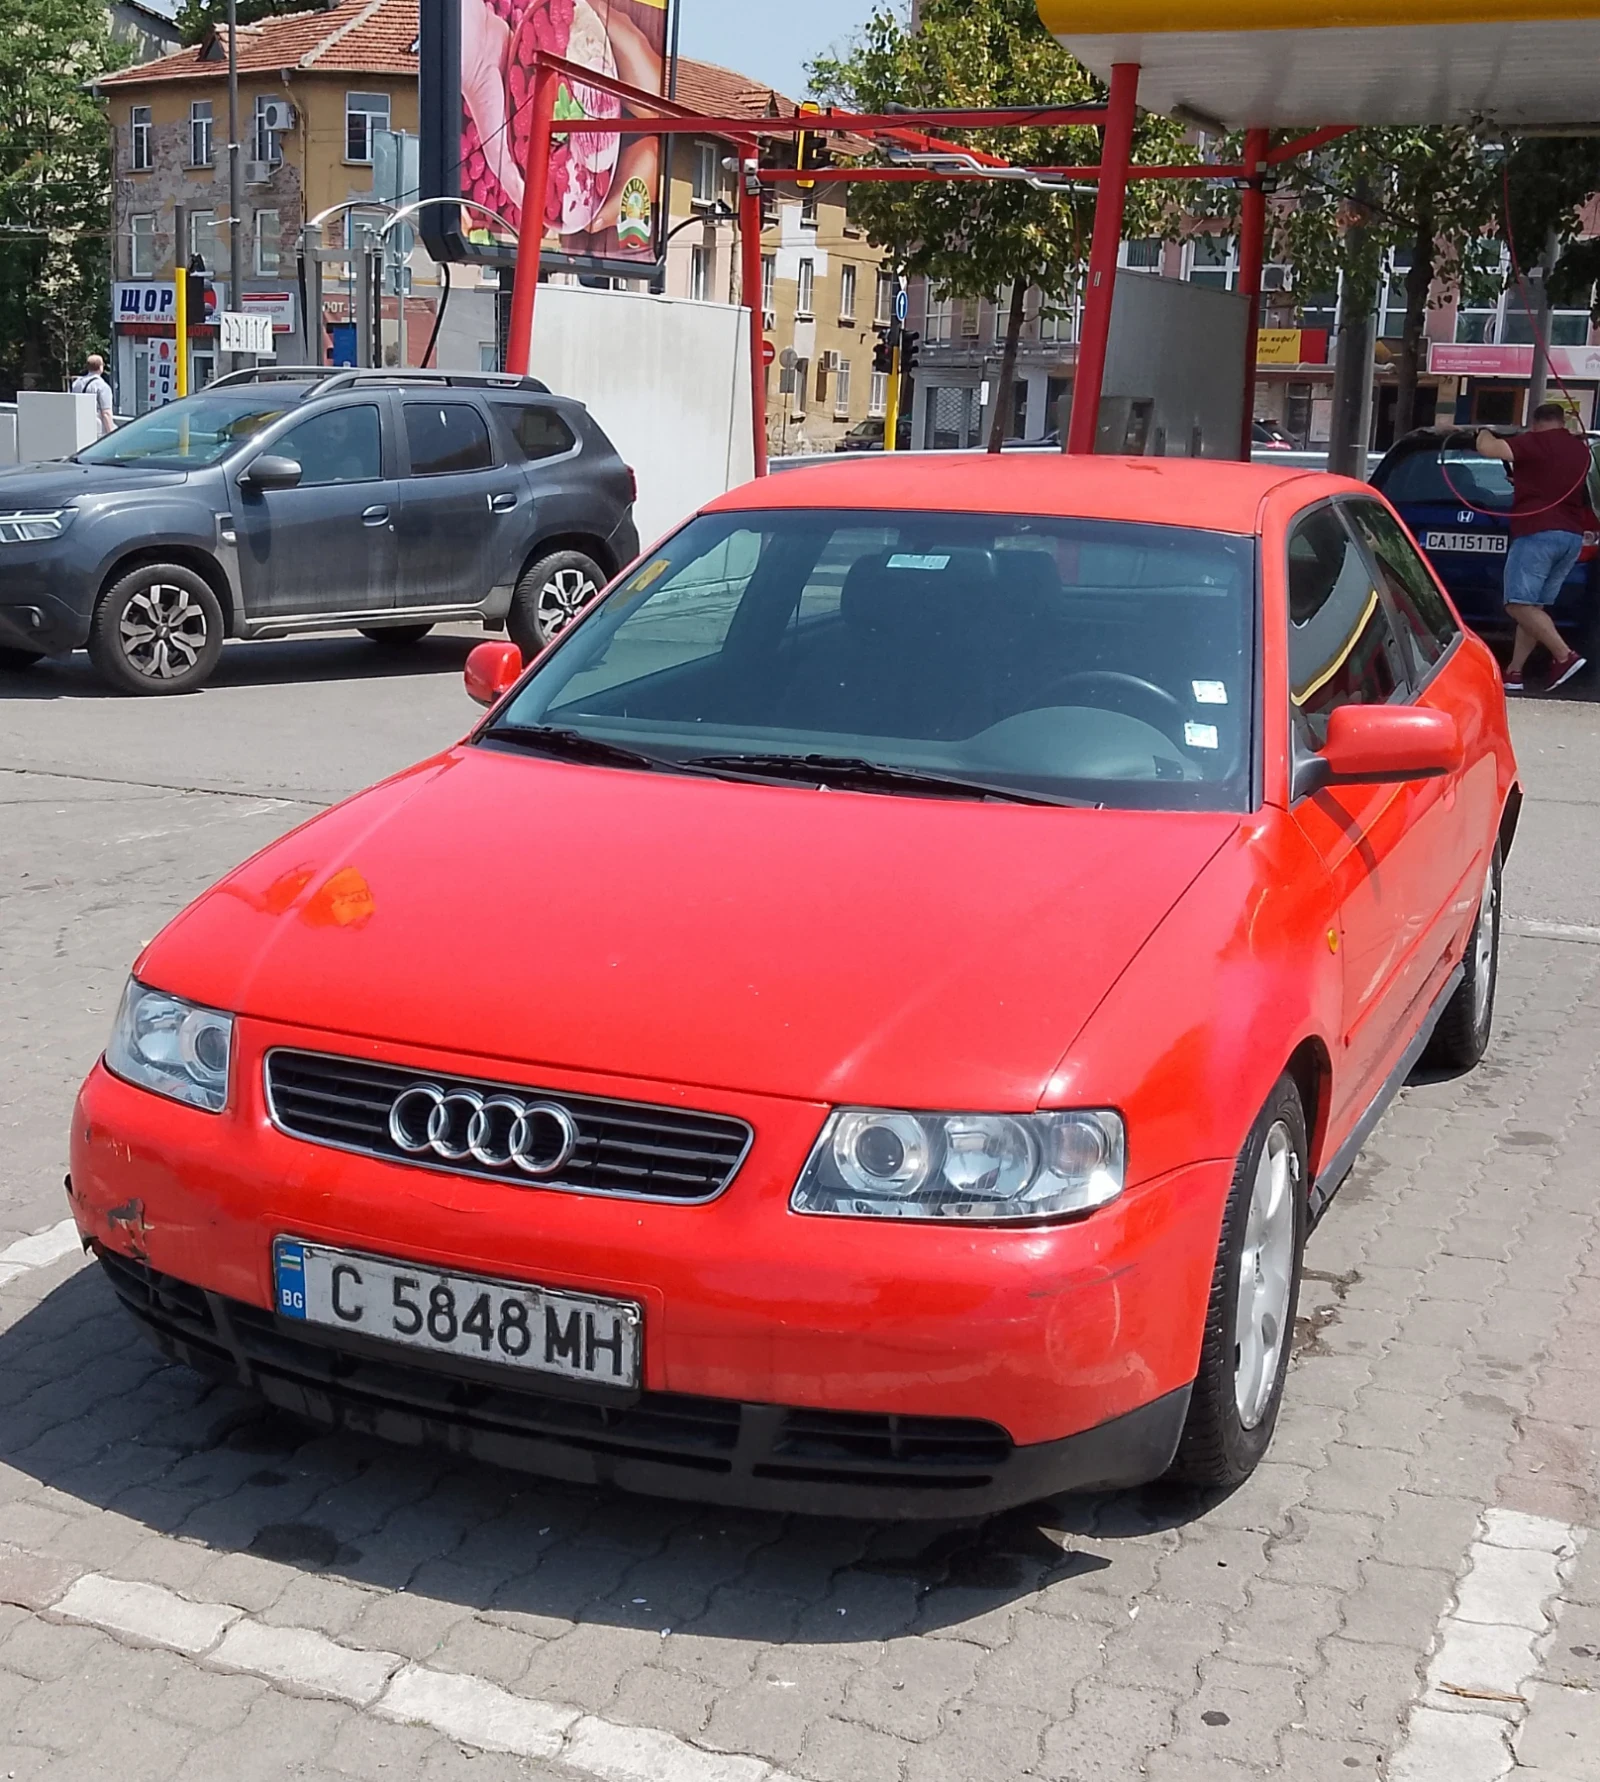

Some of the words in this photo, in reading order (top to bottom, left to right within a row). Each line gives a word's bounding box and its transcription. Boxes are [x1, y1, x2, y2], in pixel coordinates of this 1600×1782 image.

[154, 314, 176, 322] МАГА
[1271, 333, 1296, 343] кафе!
[1451, 535, 1483, 550] 1151
[282, 1288, 303, 1309] BG
[392, 1275, 532, 1357] 5848
[545, 1304, 623, 1377] MH
